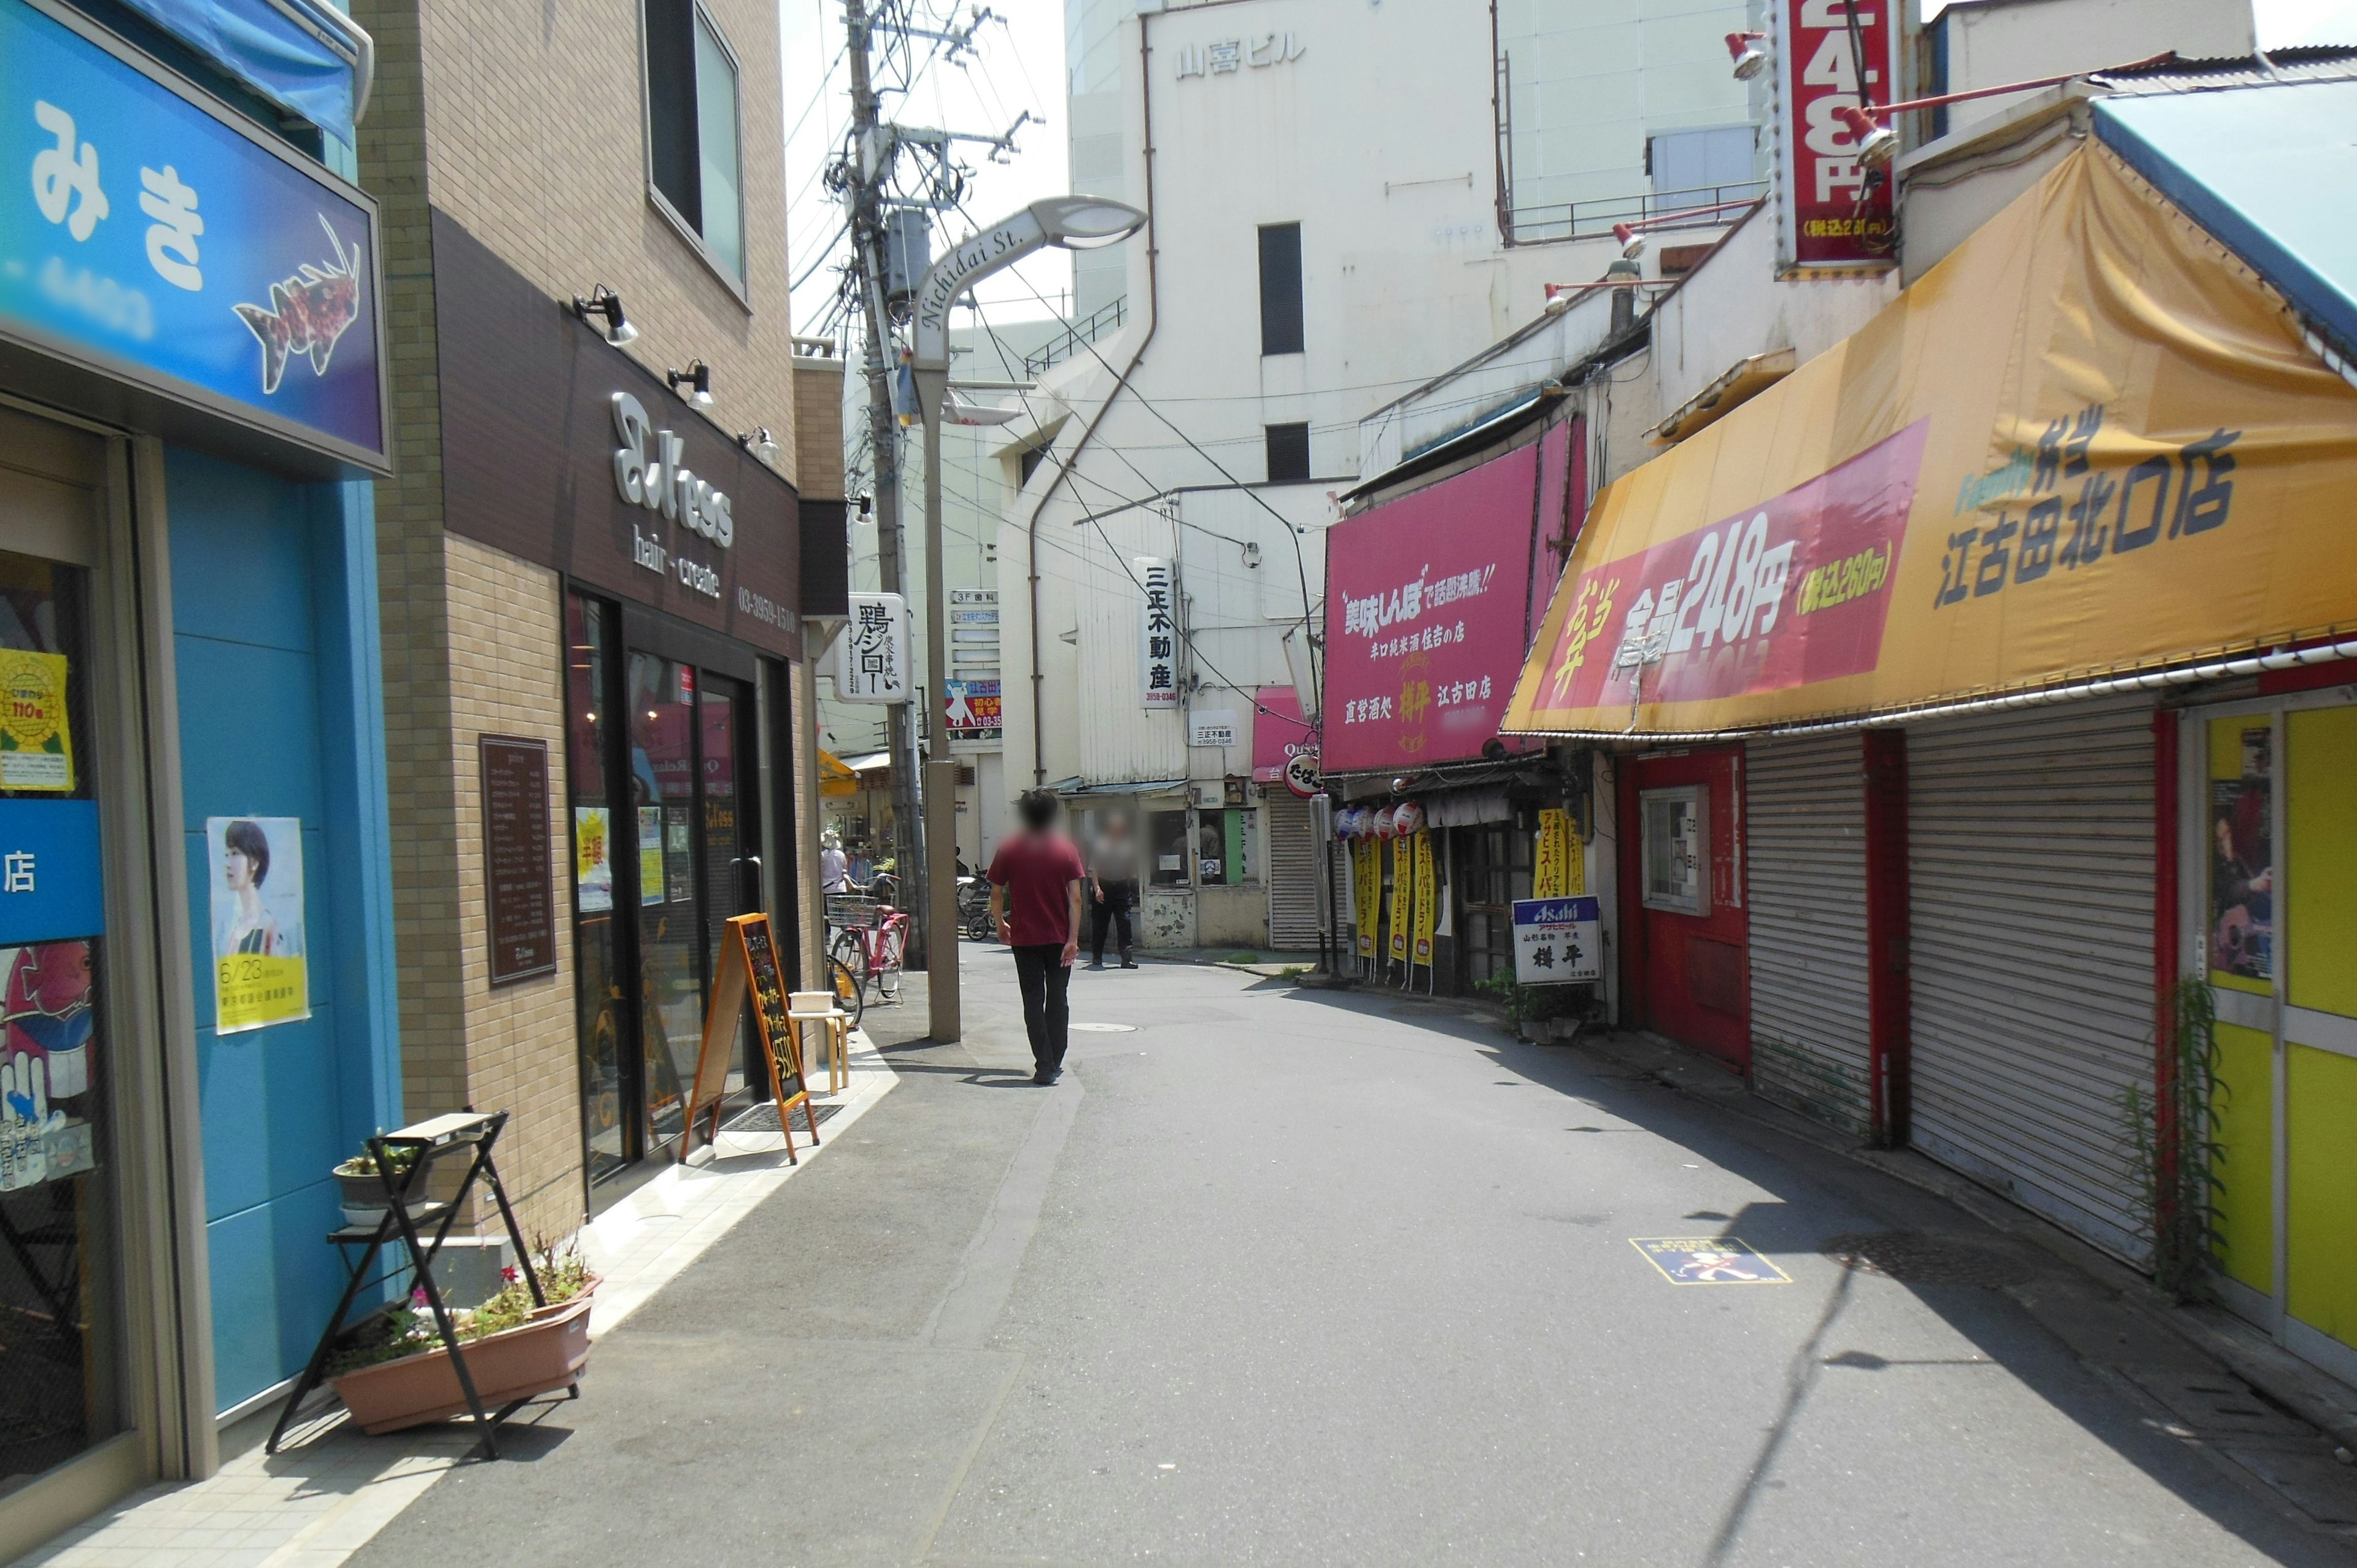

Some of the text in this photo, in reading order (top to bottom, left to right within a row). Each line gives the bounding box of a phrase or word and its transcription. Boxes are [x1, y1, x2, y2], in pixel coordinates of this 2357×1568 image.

[1176, 33, 1307, 80] 山喜ビル
[31, 99, 204, 292] みき
[922, 231, 1023, 331] Nichidai St.
[1933, 428, 2242, 610] 江古田北口店
[633, 523, 666, 574] hair
[678, 557, 721, 599] create
[738, 586, 796, 634] 03-3959-1510
[958, 593, 971, 601] 3F
[853, 601, 894, 694] 鶏ジロー
[1146, 566, 1172, 690] 三正不動産
[970, 681, 1000, 693] 江古田
[1146, 692, 1176, 701] 3958-0346
[1344, 695, 1392, 724] 直営酒処
[1437, 674, 1492, 708] 江古田店
[1197, 730, 1231, 738] 三正不動産
[3, 849, 36, 893] 店
[1535, 903, 1579, 924] Asahi
[1538, 922, 1576, 931] アサヒビール
[220, 959, 263, 984] 6/23
